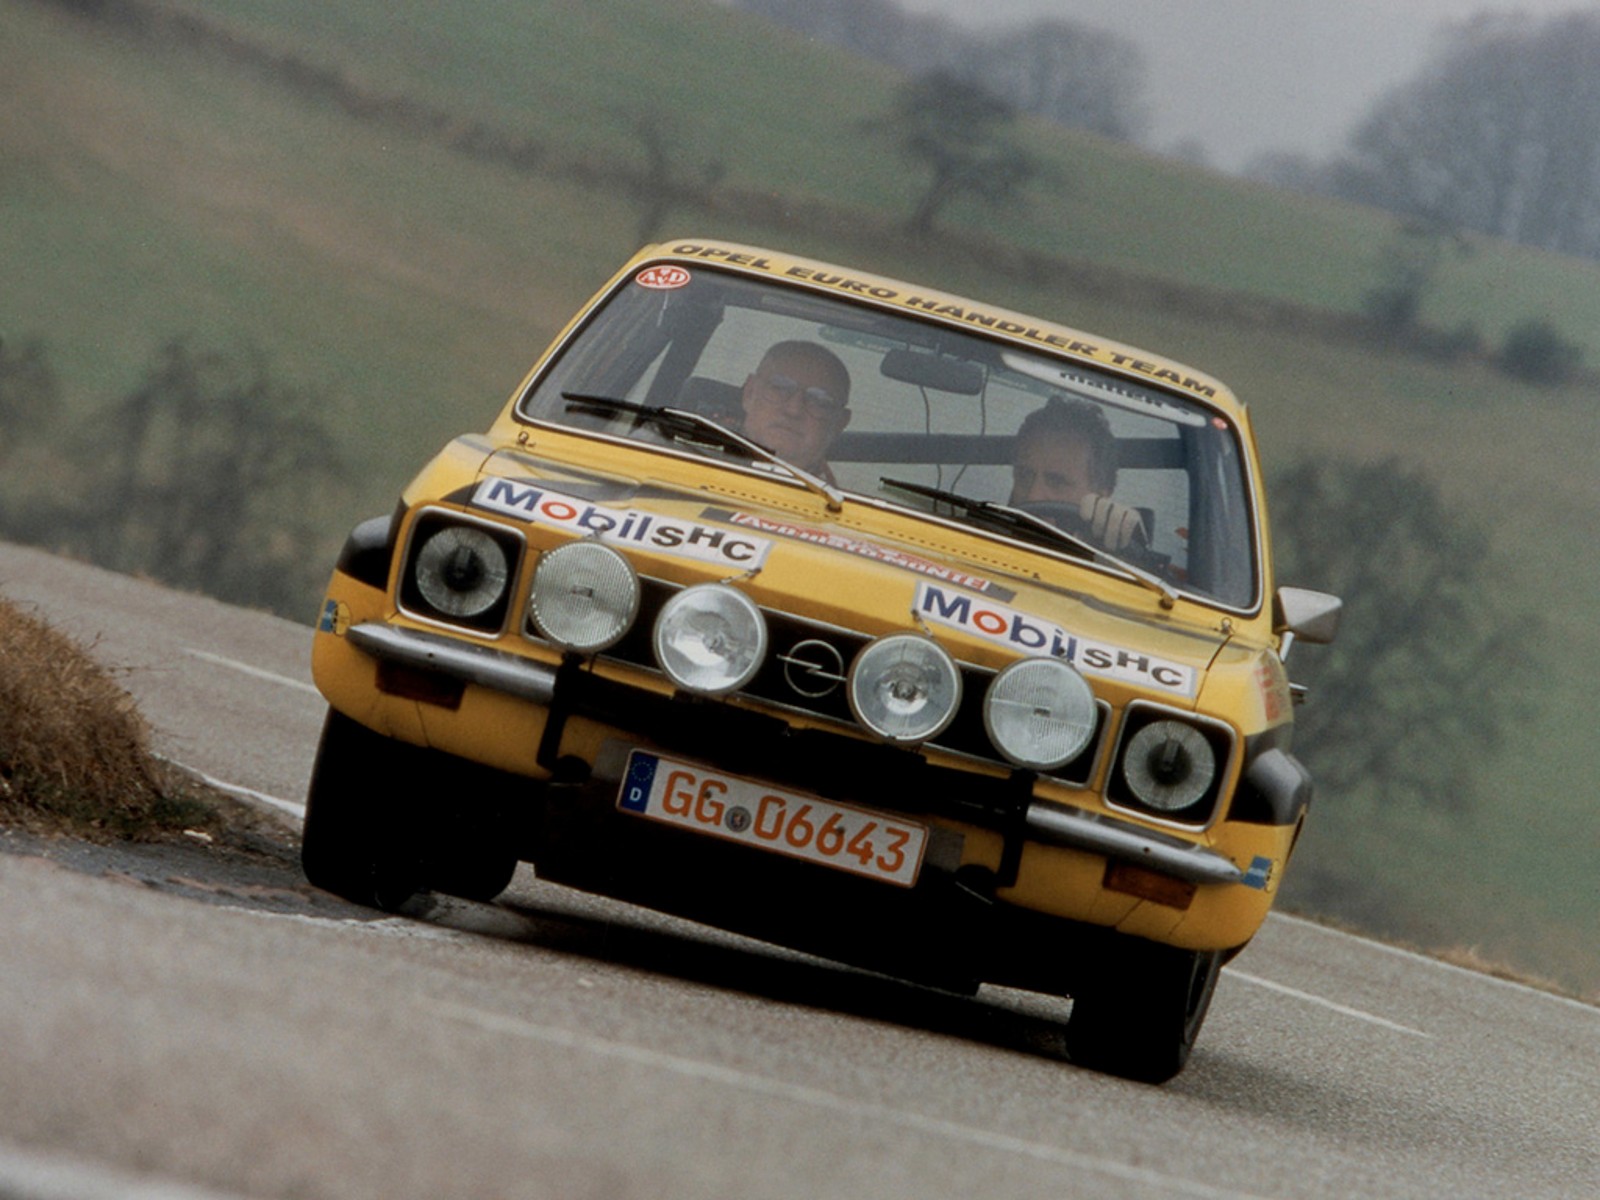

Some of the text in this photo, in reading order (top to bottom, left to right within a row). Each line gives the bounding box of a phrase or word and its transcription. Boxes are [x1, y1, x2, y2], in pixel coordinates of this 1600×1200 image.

[672, 244, 771, 270] OPEL
[785, 266, 898, 298] EURO
[1109, 351, 1217, 398] TEAM
[488, 481, 653, 542] Mobil
[922, 588, 1077, 662] Mobil
[629, 787, 642, 801] D
[662, 770, 911, 873] GG 06643
